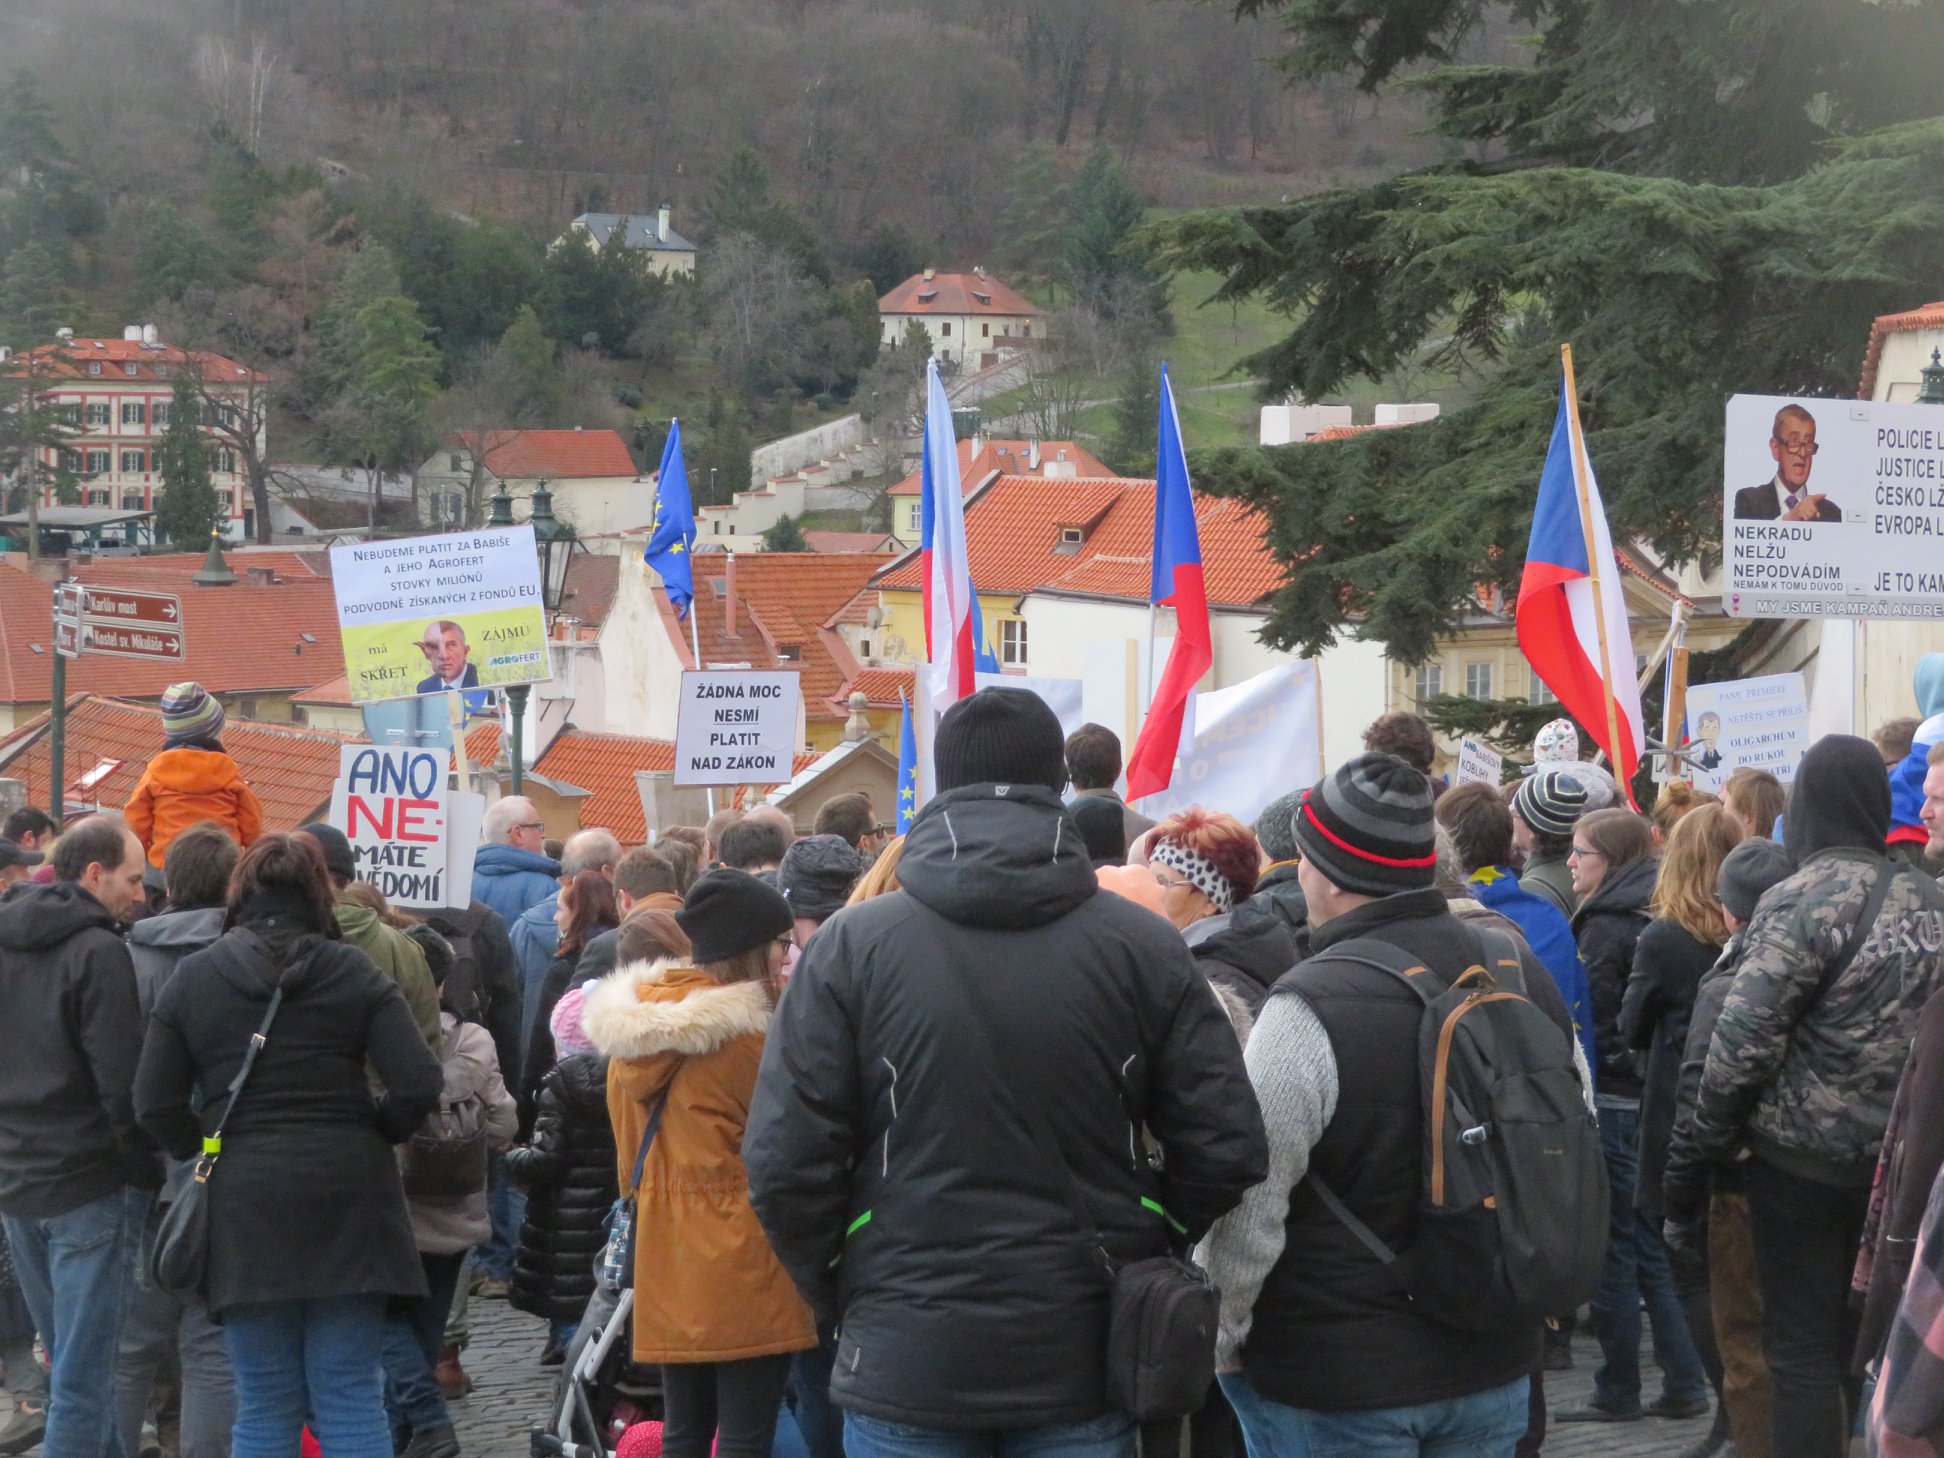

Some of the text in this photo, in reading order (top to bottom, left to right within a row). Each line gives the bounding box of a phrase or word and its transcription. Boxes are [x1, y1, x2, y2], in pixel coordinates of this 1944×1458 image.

[1877, 428, 1933, 450] POLICIE
[1876, 457, 1935, 479] JUSTICE
[1875, 481, 1925, 507] ČESKO
[1875, 514, 1933, 535] EVROPA
[1734, 526, 1812, 541] NEKRADU
[418, 542, 453, 554] PLATIT
[457, 541, 471, 551] ZA
[1734, 543, 1786, 559] NELŽU
[383, 565, 392, 575] A
[396, 561, 423, 573] JEHO
[1733, 562, 1841, 579] NEPODVÁDÍM
[390, 578, 431, 591] STOVKY
[1771, 581, 1778, 590] K
[1780, 581, 1807, 591] TOMU
[1874, 572, 1891, 592] JE
[1895, 572, 1914, 592] TO
[91, 595, 116, 613] Karlův
[118, 601, 138, 615] most
[343, 597, 404, 614] PODVODNĚ
[409, 593, 466, 608] ZÍSKANÝCH
[470, 592, 477, 601] Z
[479, 586, 516, 600] FONDŮ
[1756, 599, 1944, 617] MY JSME KAMPAŇ ANDRE
[94, 629, 118, 647] Kostel
[119, 637, 130, 648] sv.
[131, 633, 164, 652] Mikuláše
[368, 643, 388, 655] má
[489, 652, 540, 666] AGROFERT
[360, 665, 409, 682] SKŘET
[695, 682, 782, 699] ŽÁDNÁ MOC
[714, 706, 760, 723] NESMÍ
[710, 732, 761, 746] PLATIT
[691, 753, 776, 770] NAD ZÁKON
[1738, 755, 1752, 765] DO
[348, 749, 438, 800] ANO
[1461, 758, 1489, 781] KOBLIHY
[353, 842, 428, 868] MÁTE
[356, 865, 444, 902] VĚDOMÍ
